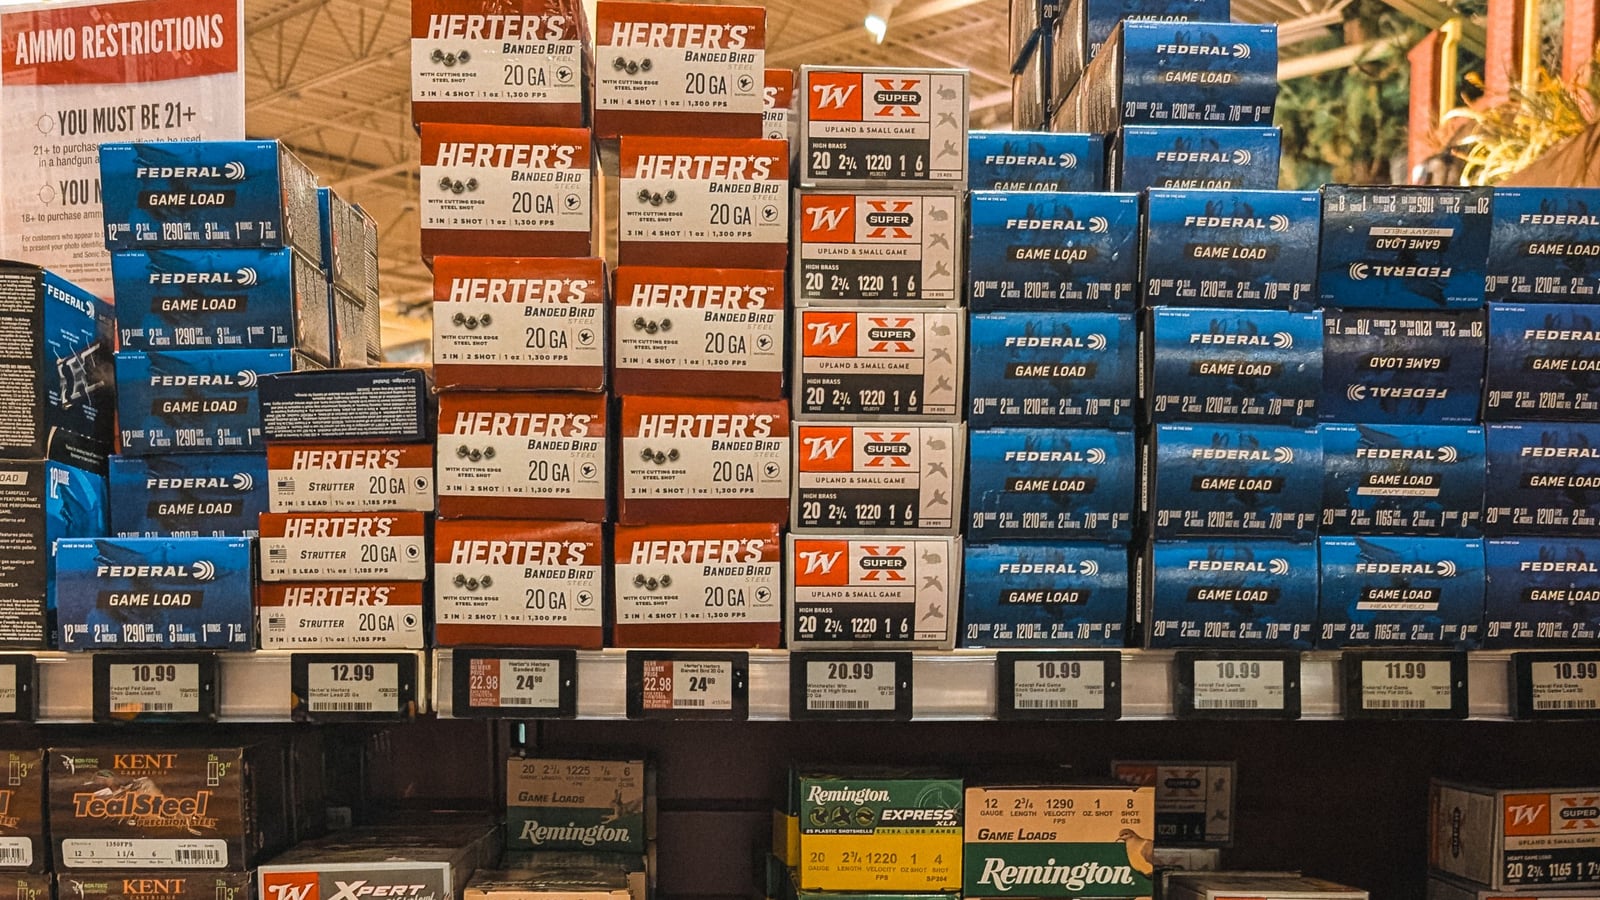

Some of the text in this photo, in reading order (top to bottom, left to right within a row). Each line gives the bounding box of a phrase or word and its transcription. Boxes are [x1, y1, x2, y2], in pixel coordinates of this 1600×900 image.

[16, 14, 224, 65] AMMO RESTRICTIONS
[1157, 45, 1230, 56] FEDERAL
[1166, 72, 1231, 84] GAME LOAD
[813, 84, 857, 109] W
[878, 94, 918, 102] SUPER
[1172, 103, 1188, 120] 1210
[58, 102, 196, 136] YOU MUST BE 21+
[33, 146, 49, 155] 21+
[53, 145, 61, 154] to
[39, 156, 93, 168] in a handgun
[813, 152, 923, 171] 20 1220 6
[511, 171, 582, 182] BANDED BIRD
[59, 179, 88, 206] YOU
[512, 192, 554, 214] 20 GA
[22, 214, 35, 222] 18+
[47, 212, 81, 223] purchase
[32, 233, 60, 241] customers
[75, 232, 92, 240] appear
[1376, 238, 1441, 249] GAME LOAD
[1373, 266, 1451, 278] FEDERAL
[47, 285, 86, 313] FEDERAL
[712, 440, 780, 451] BANDED BIRD
[1005, 452, 1083, 462] FEDERAL
[1356, 449, 1435, 460] FEDERAL
[713, 461, 753, 482] 20 GA
[1015, 480, 1085, 492] GAME LOAD
[1370, 476, 1433, 486] GAME LOAD
[361, 545, 397, 562] 20 GA
[864, 559, 902, 567] SUPER
[97, 566, 188, 577] FEDERAL
[109, 594, 192, 606] GAME LOAD
[64, 624, 145, 643] 12 1290
[132, 665, 175, 682] 10.99
[331, 665, 374, 681] 12.99
[828, 663, 873, 679] 20.99
[1037, 663, 1080, 678] 10.99
[1217, 663, 1260, 679] 10.99
[1385, 663, 1426, 679] 11.99
[1554, 663, 1597, 679] 10.99
[471, 676, 498, 690] 22.98
[644, 678, 671, 692] 22.98
[114, 754, 178, 769] KENT
[566, 766, 591, 775] 1225
[518, 791, 585, 803] GAME LOADS
[807, 786, 890, 806] Remington
[73, 790, 210, 818] TealSteel
[985, 799, 1134, 809] 12 1290 1 8
[136, 818, 216, 827] PRECISION STEEL
[881, 810, 954, 821] EXPRESS
[519, 820, 630, 847] Remington
[978, 828, 1057, 841] GAME LOADS
[810, 853, 942, 865] 20 1220 4
[977, 858, 1133, 892] Remington
[1508, 862, 1572, 878] 20 1165
[328, 880, 426, 900] XPERT
